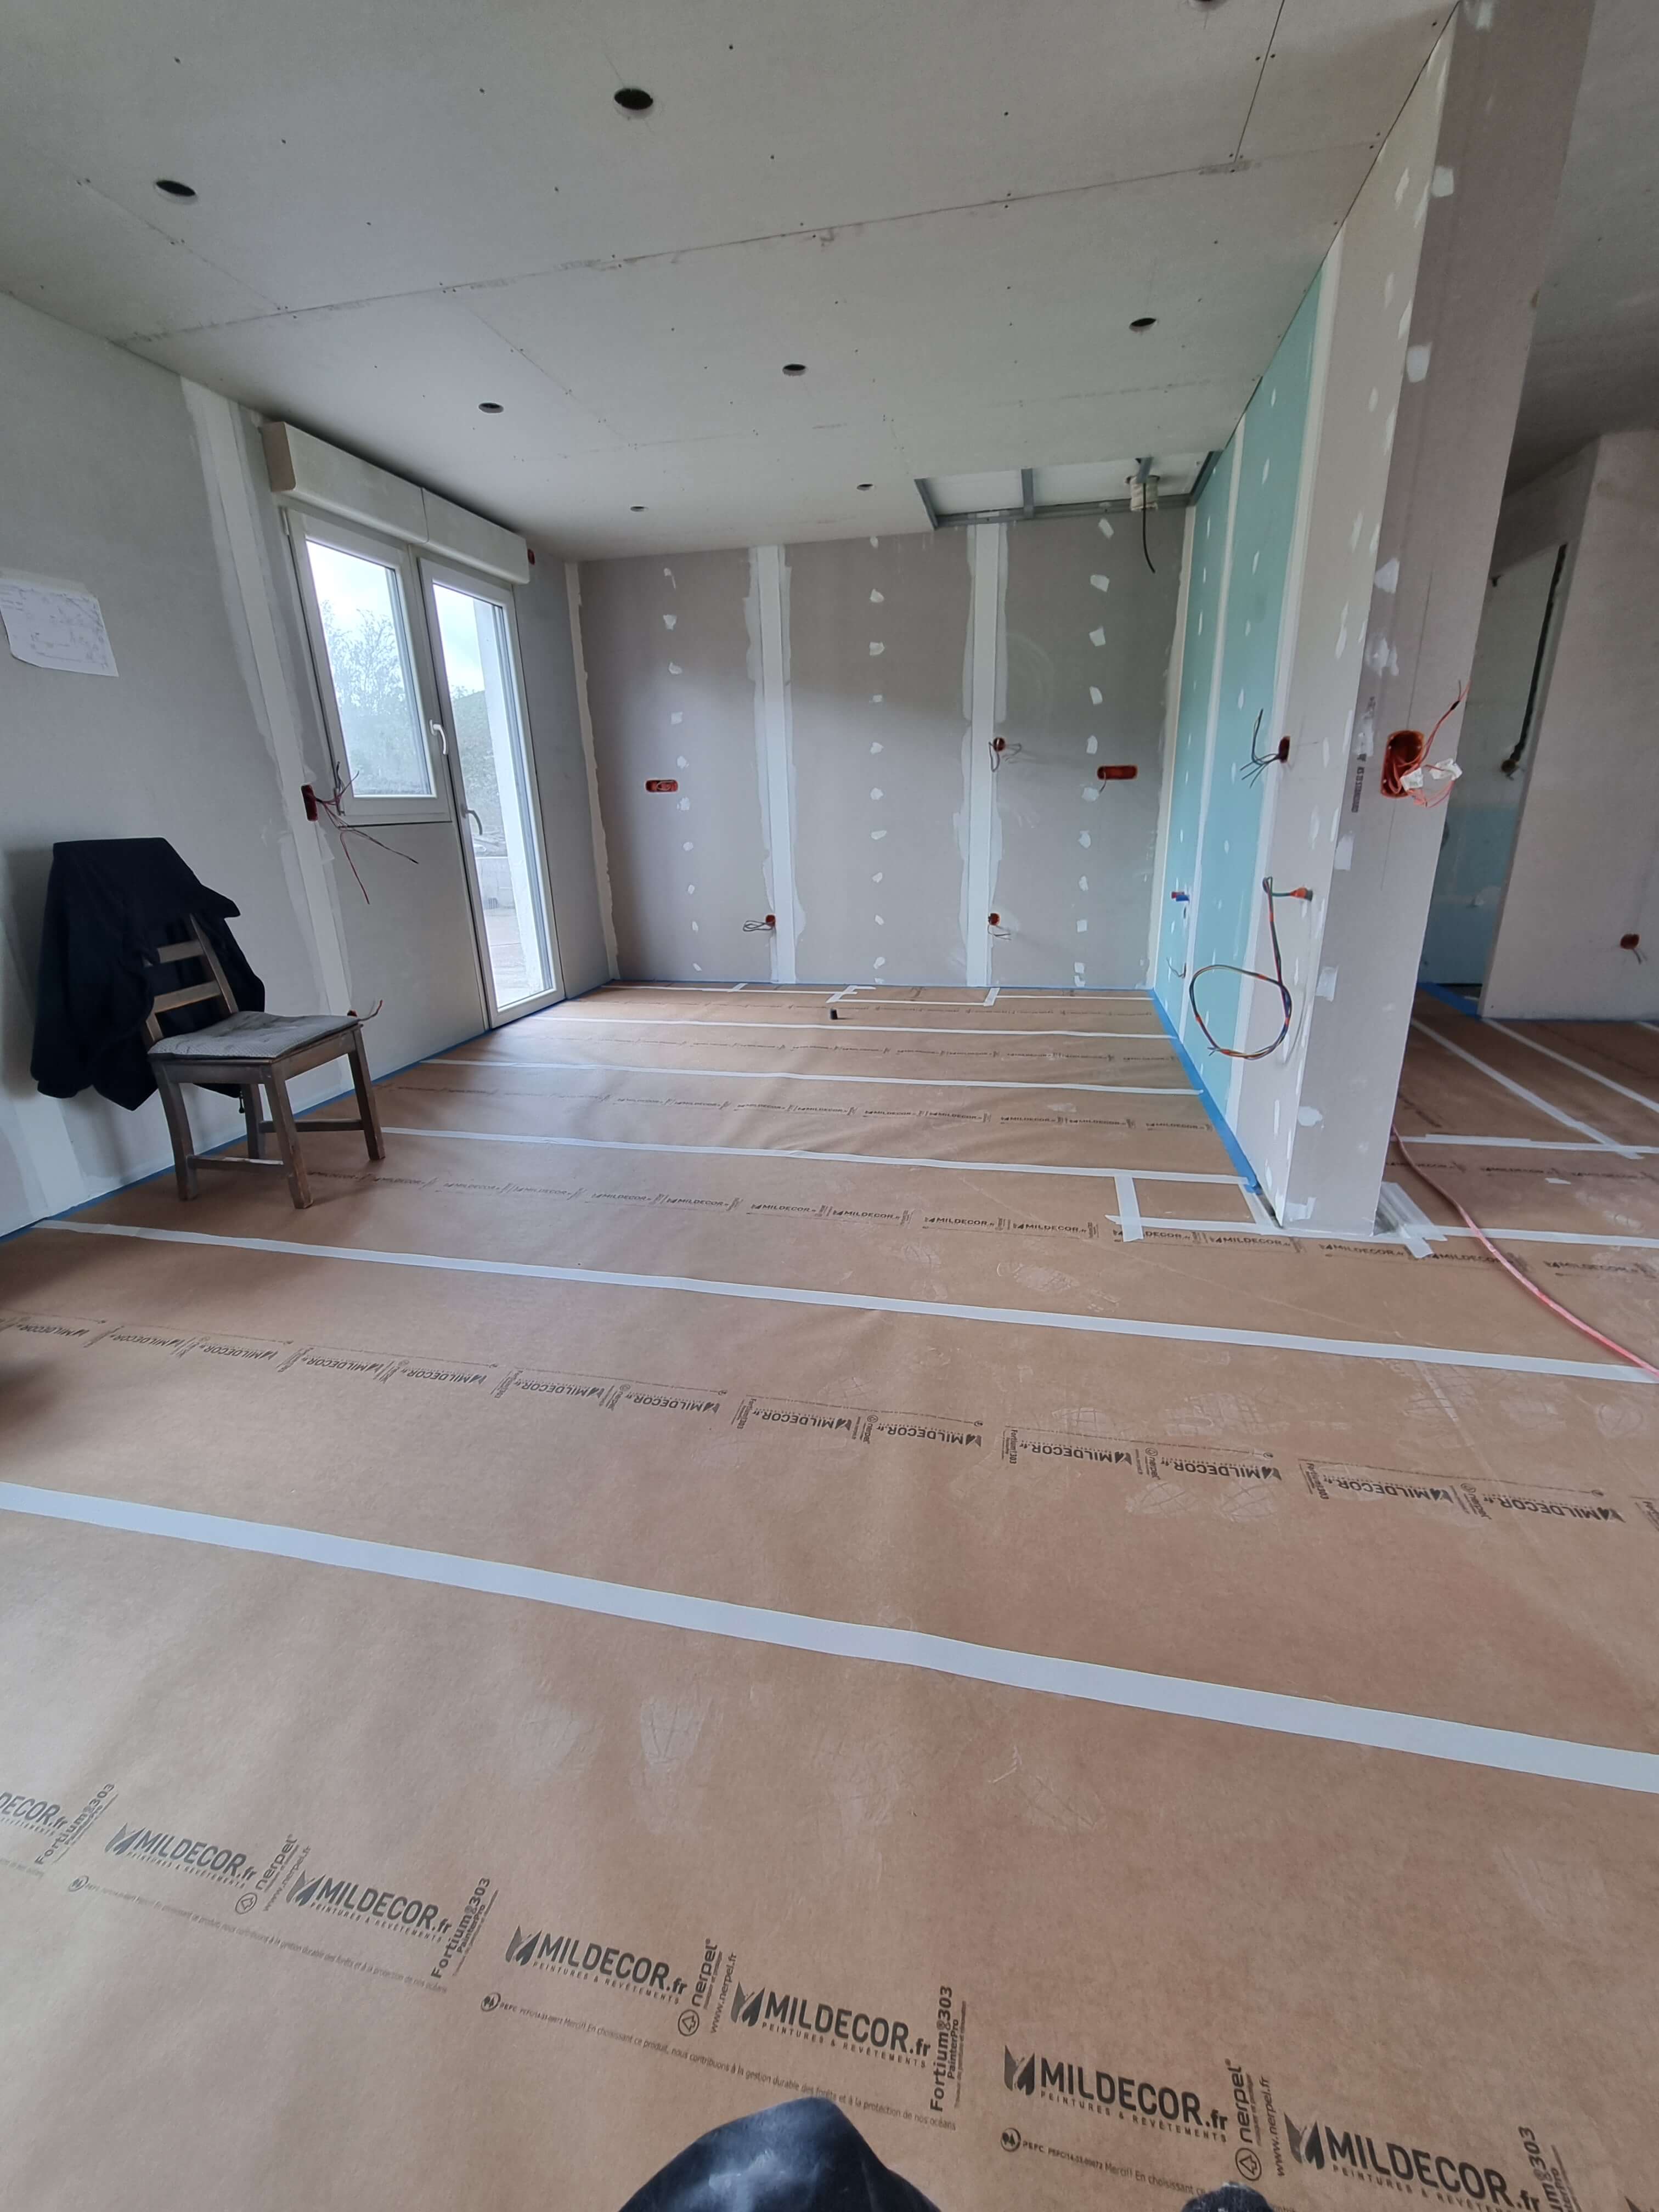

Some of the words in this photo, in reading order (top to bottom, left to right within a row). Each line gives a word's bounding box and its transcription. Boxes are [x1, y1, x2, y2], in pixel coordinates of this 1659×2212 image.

[133, 1830, 258, 1881] MILDECOR.fr
[315, 1877, 453, 1934] MILDECOR.fr
[537, 1932, 689, 1996] MILDECOR.fr
[764, 1990, 932, 2057] MILDECOR.fr
[947, 2018, 960, 2080] PainterPro
[1040, 2057, 1229, 2131] MILDECOR.fr
[1259, 2075, 1286, 2178] www.nerpel.fr
[1324, 2125, 1540, 2212] MILDECOR.fr
